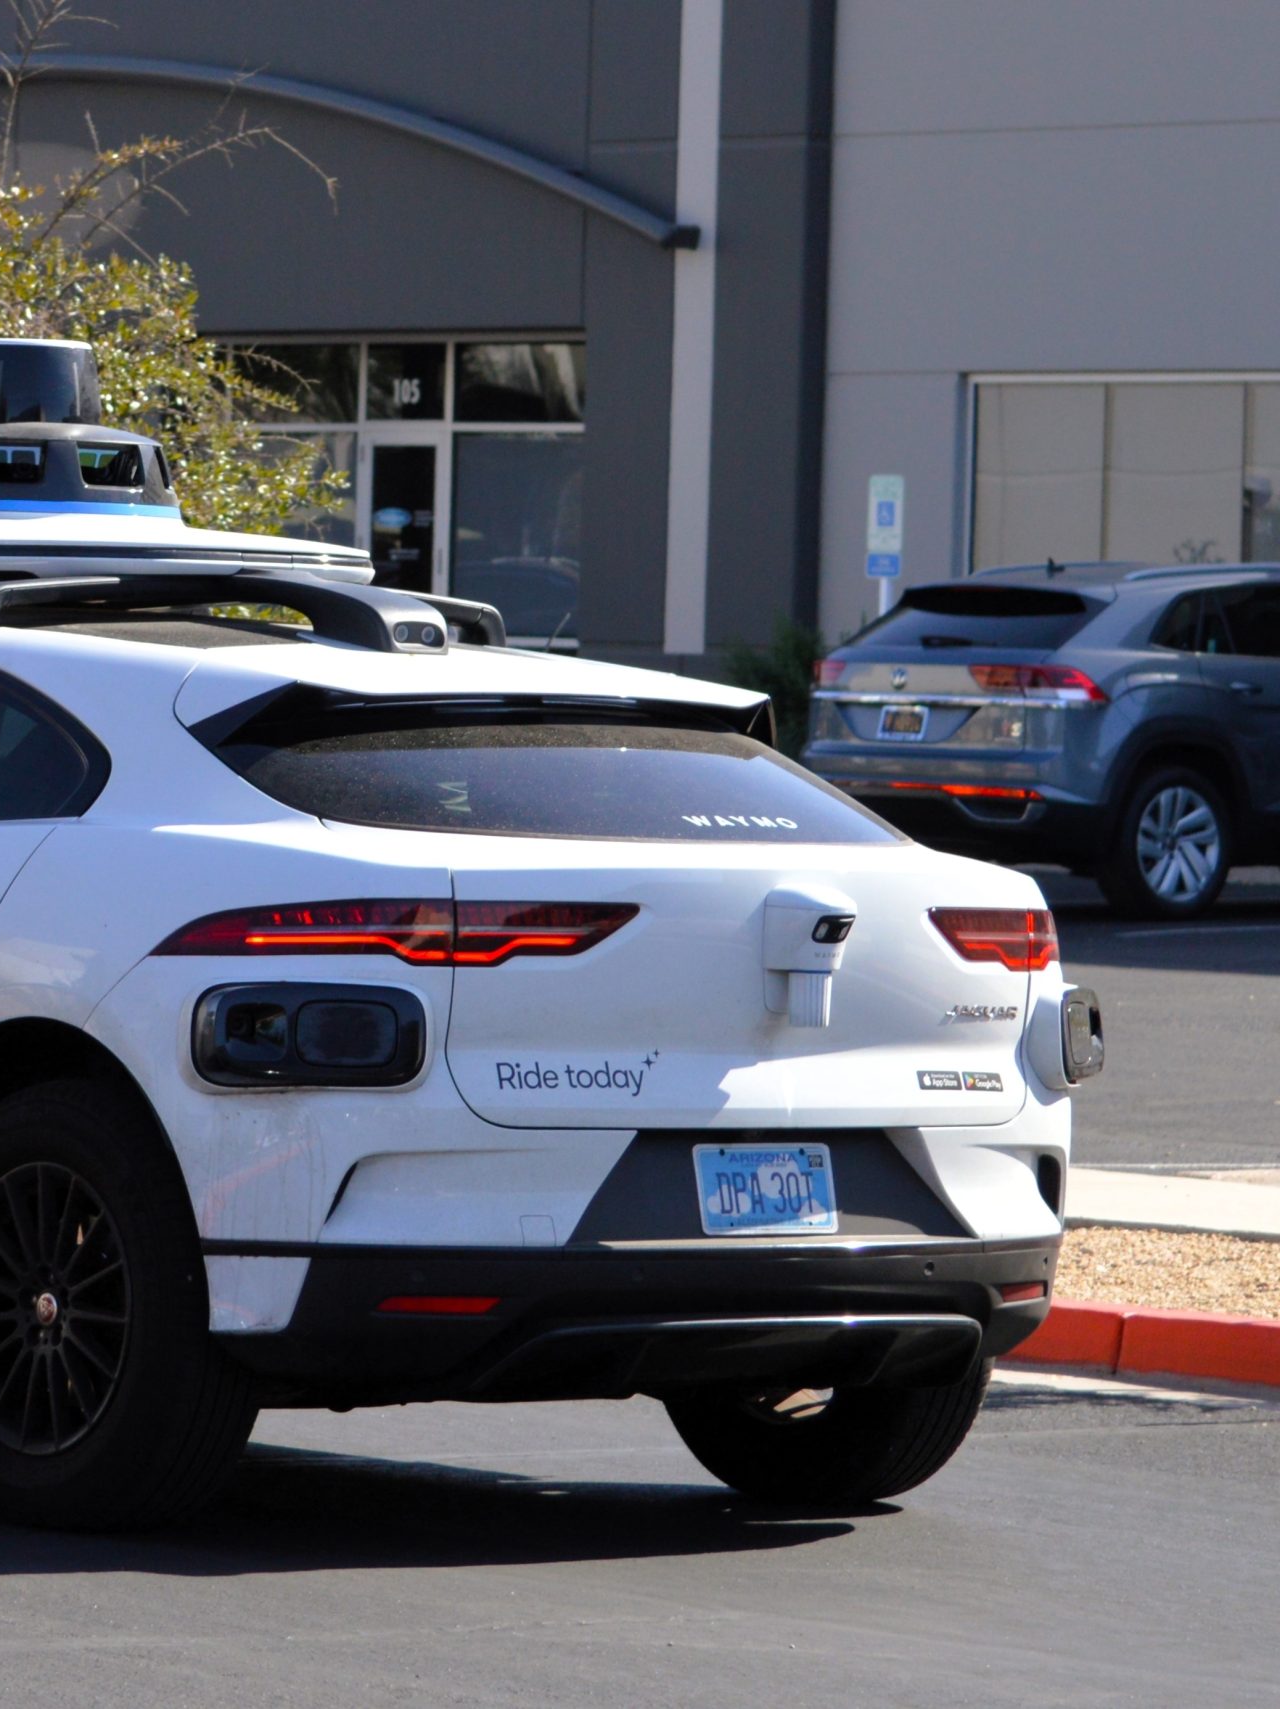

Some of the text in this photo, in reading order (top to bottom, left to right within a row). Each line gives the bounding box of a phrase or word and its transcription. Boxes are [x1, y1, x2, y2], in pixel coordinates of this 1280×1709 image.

[393, 378, 420, 405] 105
[681, 815, 799, 830] WAYMO
[496, 1061, 644, 1097] Ride today
[728, 1153, 798, 1164] ARIZONA
[716, 1172, 814, 1215] DPA 30T
